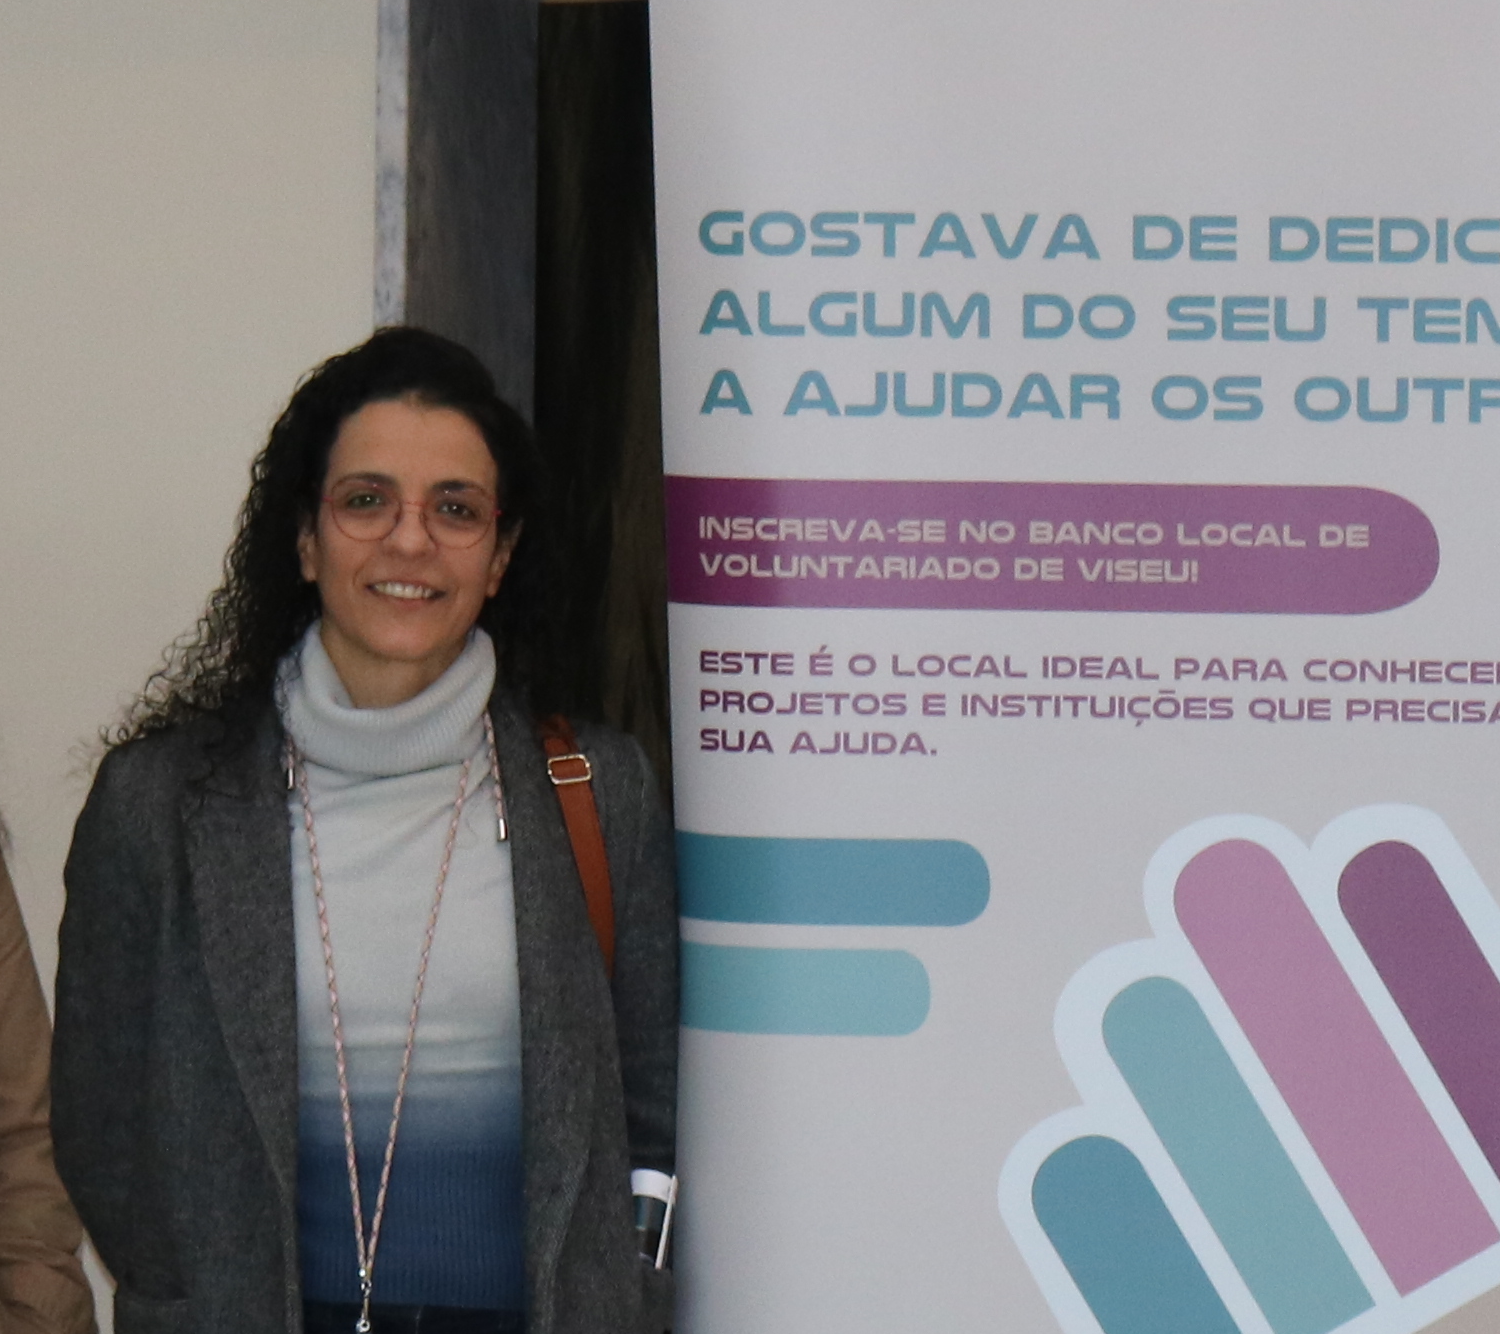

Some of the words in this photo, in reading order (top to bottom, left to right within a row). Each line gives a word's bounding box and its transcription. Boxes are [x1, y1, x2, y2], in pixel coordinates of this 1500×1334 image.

[698, 209, 1100, 260] GOSTAVA
[1132, 215, 1237, 261] DE
[698, 290, 991, 338] ALGUM
[1022, 293, 1135, 340] DO
[1166, 295, 1326, 342] SEU
[699, 369, 752, 415] A
[783, 370, 1120, 420] AJUDAR
[1151, 375, 1263, 421] OS
[698, 515, 947, 545] INSCREVA-SE
[959, 520, 1015, 543] NO
[1029, 521, 1163, 545] BANCO
[1177, 523, 1306, 547] LOCAL
[1319, 524, 1369, 547] DE
[699, 554, 1001, 581] VOLUNTARIADO
[1014, 558, 1063, 581] DE
[1077, 559, 1198, 583] VISEU!
[699, 649, 793, 675] ESTE
[809, 645, 833, 676] É
[848, 654, 877, 676] O
[892, 654, 1022, 678] LOCAL
[1042, 656, 1159, 680] IDEAL
[1174, 657, 1287, 681] PARA
[698, 686, 906, 715] PROJETOS
[922, 693, 946, 716] E
[961, 690, 1234, 727] INSTITUIÇÕES
[1249, 698, 1331, 723] QUE
[699, 727, 773, 752] SUA
[789, 731, 937, 755] AJUDA.
